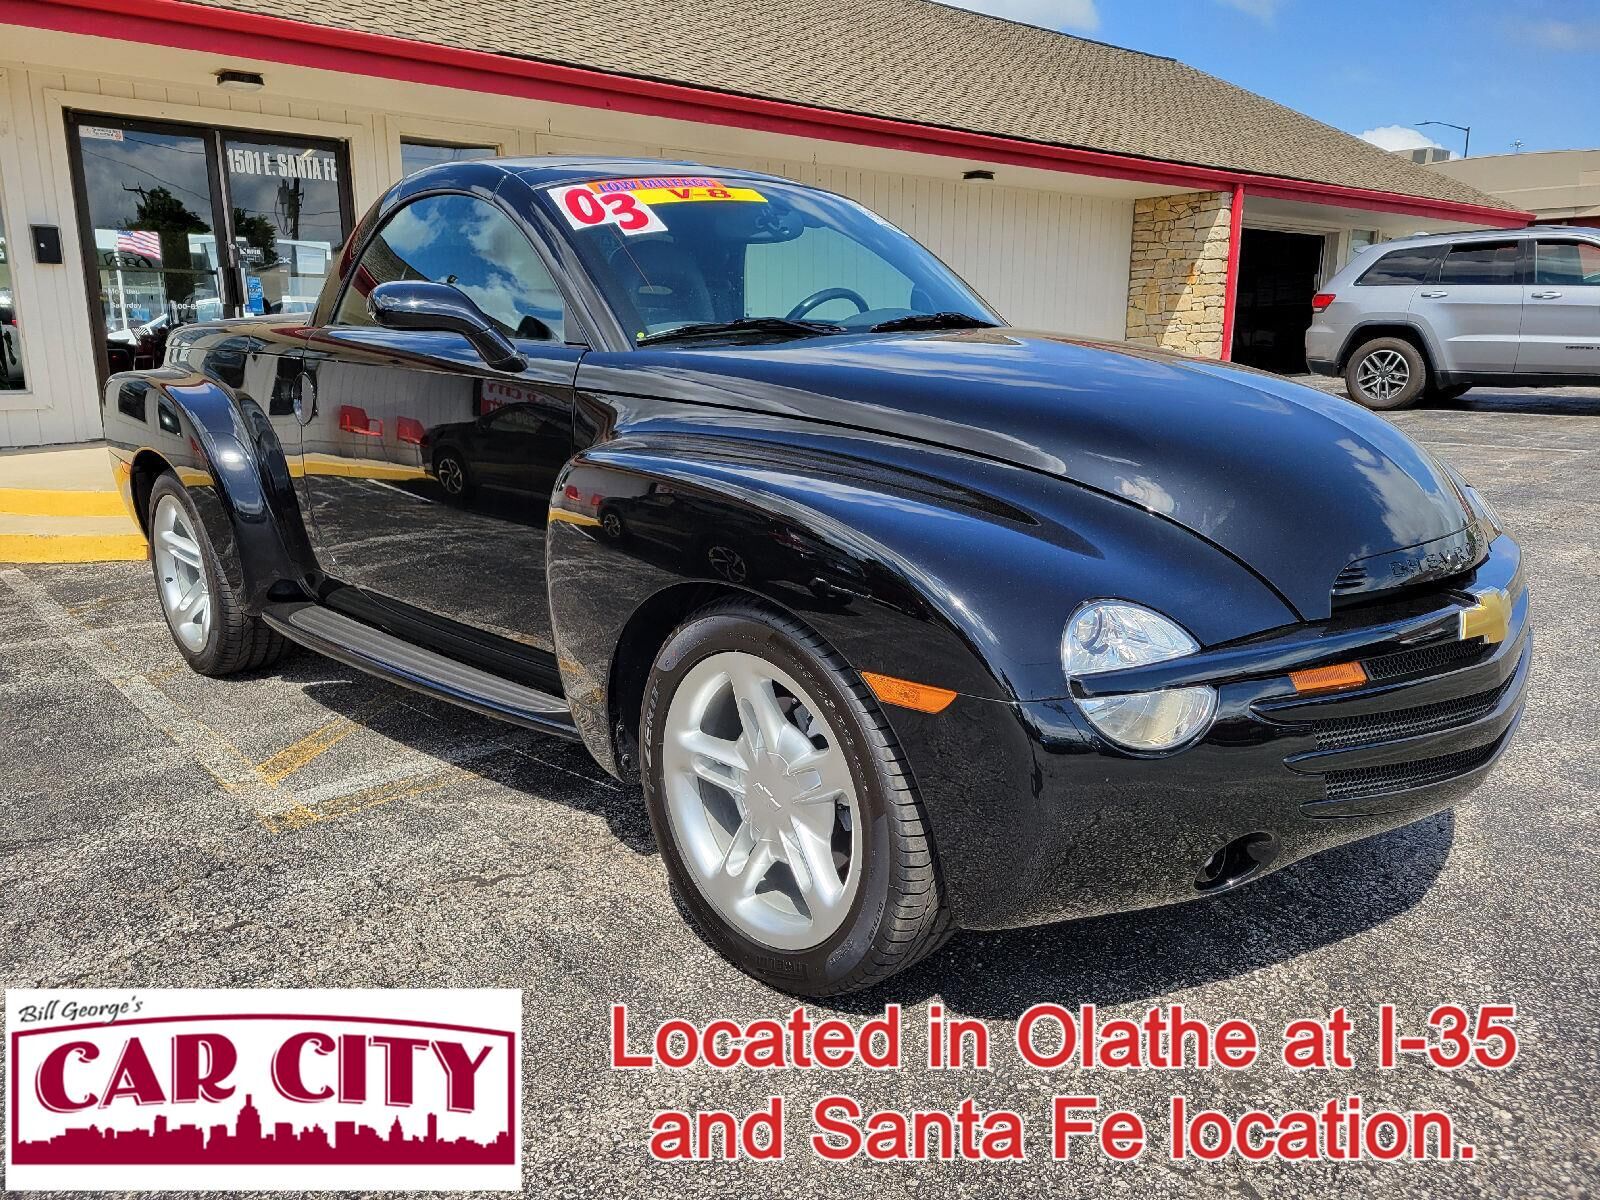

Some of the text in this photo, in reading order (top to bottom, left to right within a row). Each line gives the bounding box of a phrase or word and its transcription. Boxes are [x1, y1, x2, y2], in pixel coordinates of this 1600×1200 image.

[226, 148, 338, 181] 1501 E. SANTA FE
[599, 177, 716, 193] LOW MILEAGE
[667, 188, 732, 199] V-8
[564, 188, 649, 230] 03
